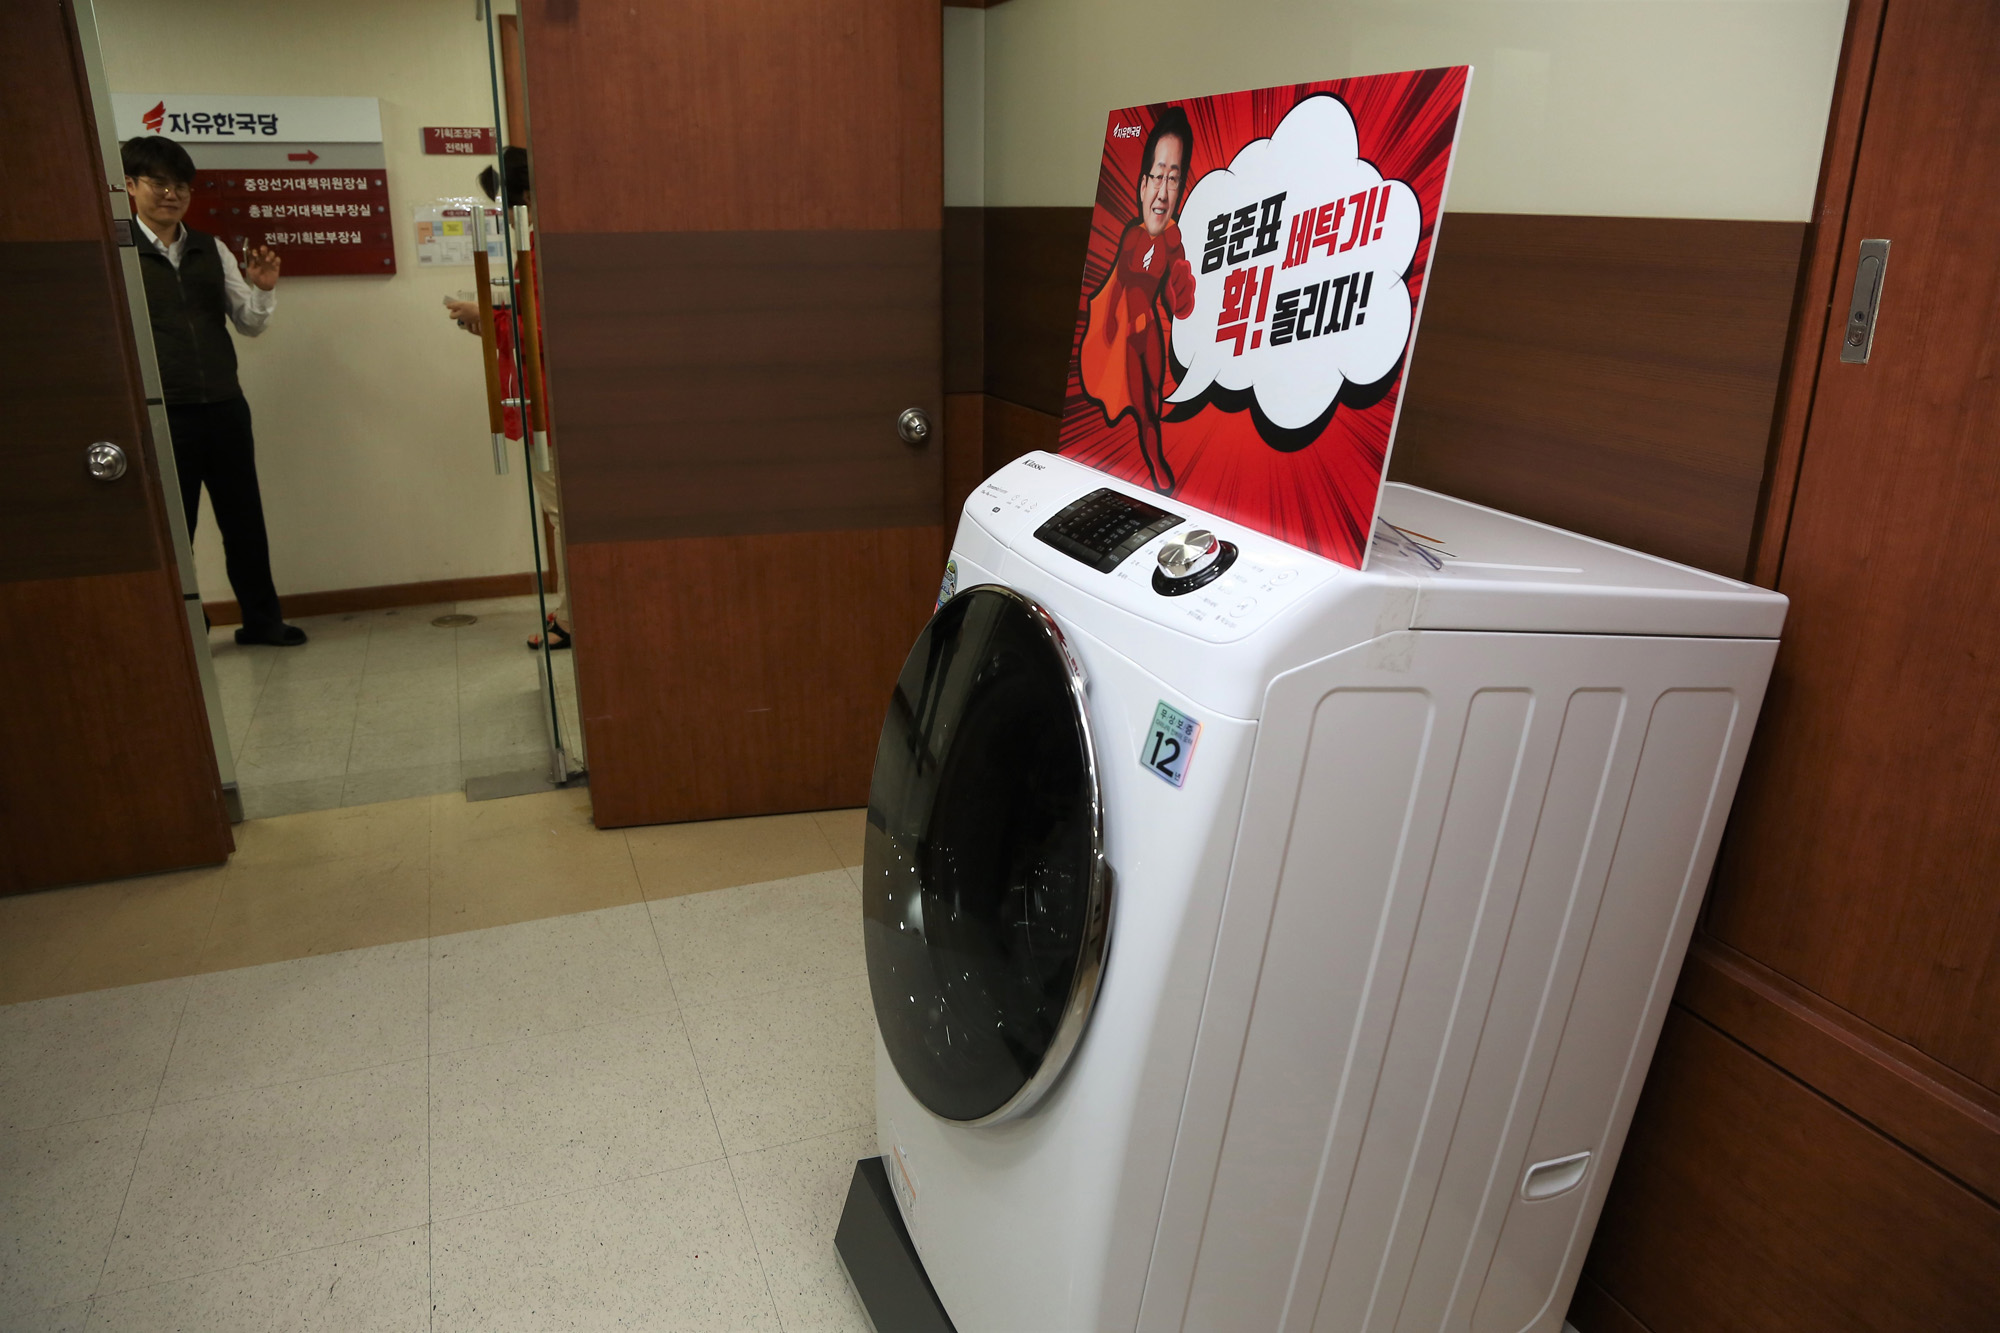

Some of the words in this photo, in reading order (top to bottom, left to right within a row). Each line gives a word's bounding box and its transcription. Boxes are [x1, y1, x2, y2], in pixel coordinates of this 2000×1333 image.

[169, 112, 278, 135] 자유한국당
[434, 128, 482, 139] 기획조정국
[445, 142, 473, 153] 전략팀
[244, 177, 368, 192] 중앙선거대책위원장실
[248, 204, 371, 218] 총괄선거대책본부장실
[1200, 191, 1287, 274] 홍준표
[1281, 184, 1392, 270] 세탁기!
[265, 231, 362, 245] 전략기획본부장실
[1214, 265, 1274, 357] 확!
[1269, 270, 1374, 347] 돌리자!
